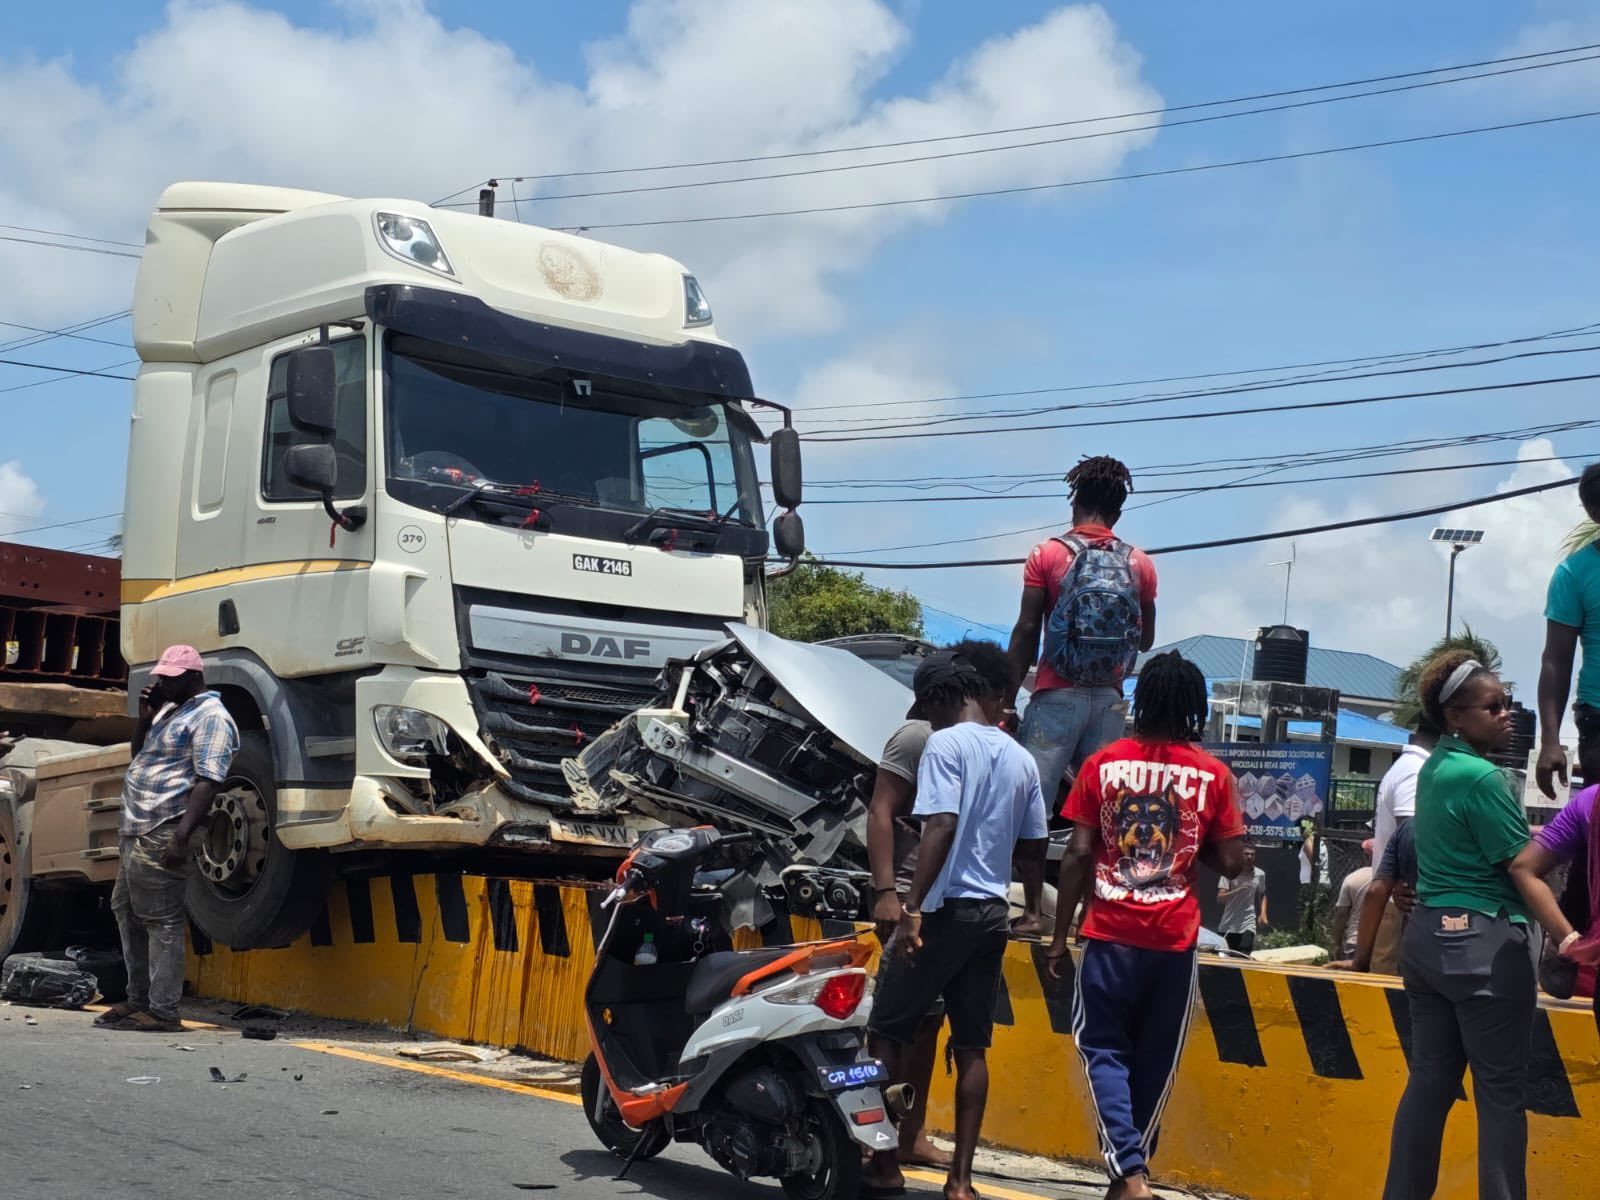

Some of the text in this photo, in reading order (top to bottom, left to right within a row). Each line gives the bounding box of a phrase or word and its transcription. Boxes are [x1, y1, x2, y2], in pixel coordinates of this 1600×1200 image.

[402, 533, 423, 544] 379
[574, 556, 630, 576] GAK 2146
[560, 632, 650, 660] DAF
[1099, 759, 1216, 813] PROTECT
[828, 1070, 846, 1084] CR
